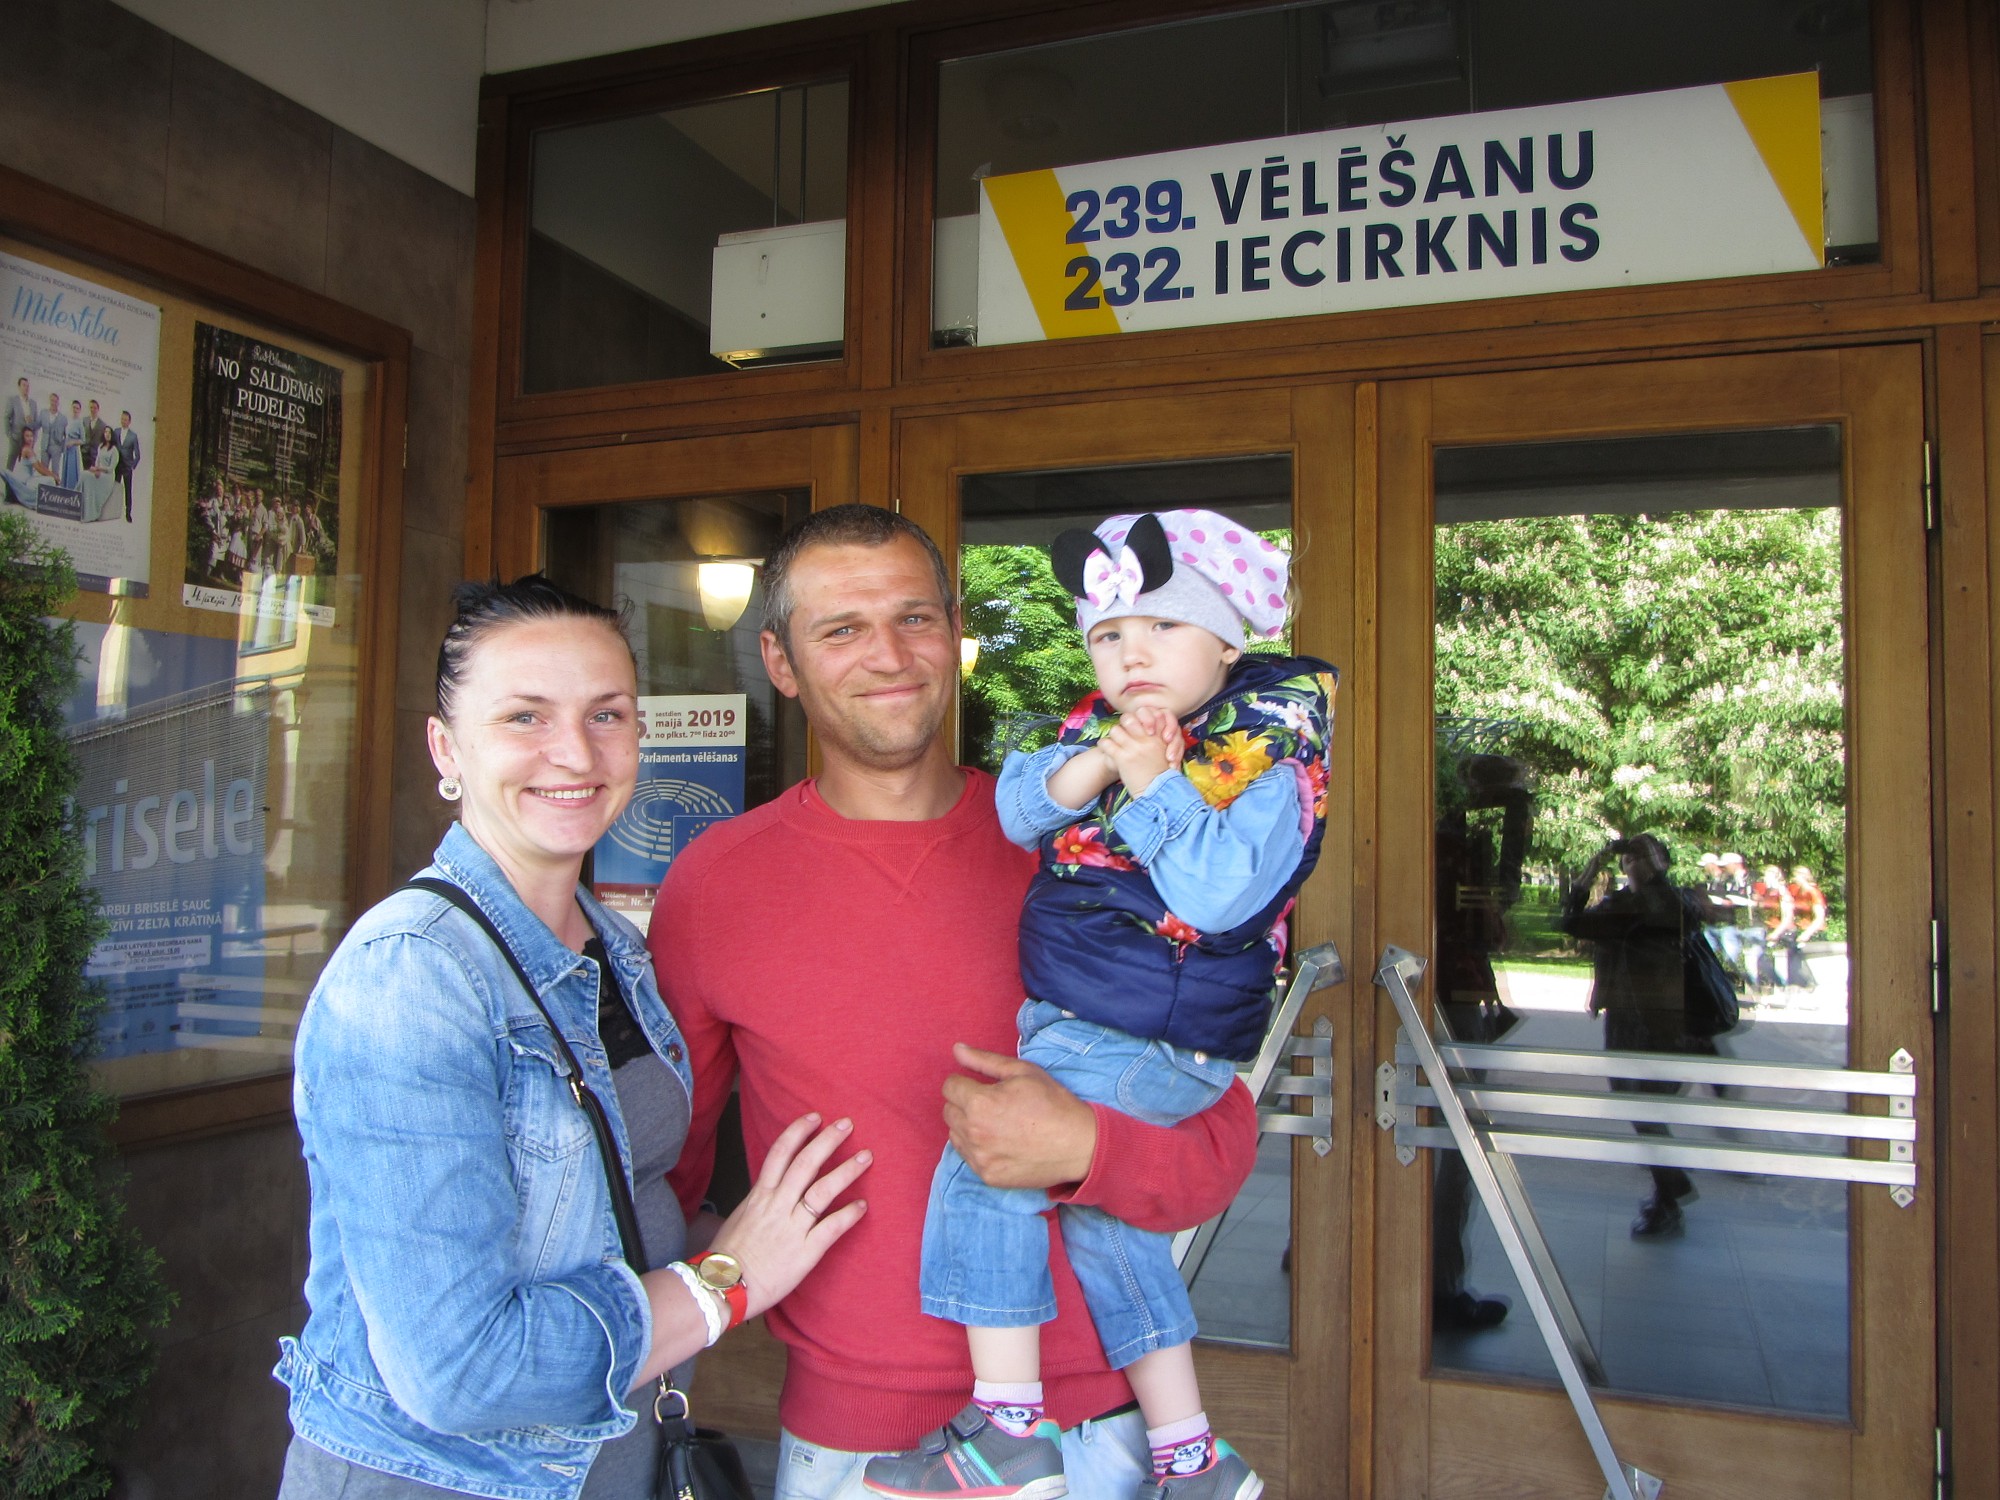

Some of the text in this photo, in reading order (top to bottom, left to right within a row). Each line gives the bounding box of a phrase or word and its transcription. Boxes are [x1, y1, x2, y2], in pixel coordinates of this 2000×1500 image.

[1065, 130, 1594, 245] 239. VĒLĒŠANU
[1064, 202, 1600, 311] 232. IECIRKNIS
[12, 285, 121, 347] Mīlestība
[217, 356, 240, 380] NO
[249, 366, 323, 406] SALDENĀS
[237, 388, 305, 424] PUDELES
[655, 709, 735, 729] maijā 2019
[666, 731, 688, 740] plkst.
[639, 751, 738, 764] Parlamenta vēlēšanas
[95, 899, 212, 916] ARBU BRISELĒ SAUC
[630, 897, 643, 907] Nr.
[110, 919, 134, 932] ZĪVI
[137, 918, 171, 930] ZELTA
